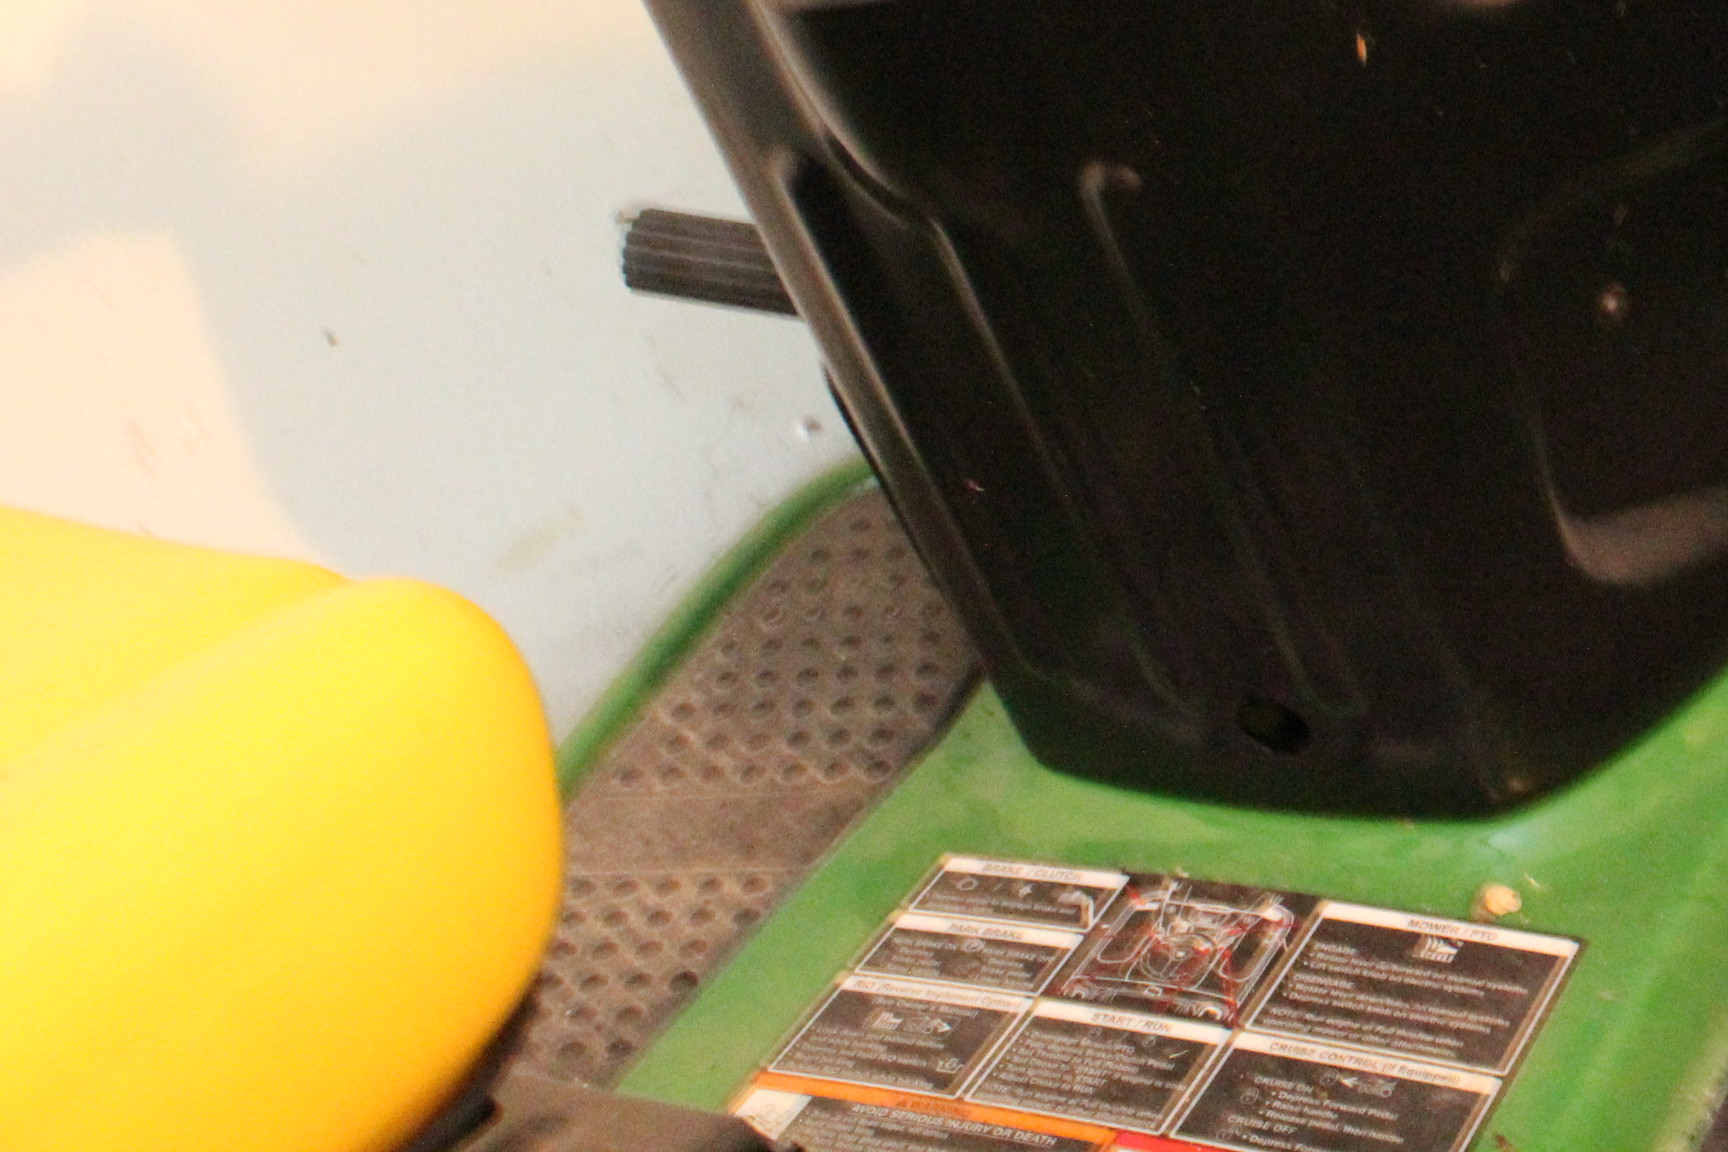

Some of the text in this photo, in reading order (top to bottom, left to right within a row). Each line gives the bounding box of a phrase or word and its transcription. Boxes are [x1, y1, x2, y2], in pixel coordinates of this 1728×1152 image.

[982, 863, 1024, 875] BRAKE
[1034, 867, 1083, 881] CLUTCH
[948, 924, 1024, 939] PARK BRAKE
[1408, 919, 1460, 935] MOWER
[1470, 929, 1498, 940] PTO
[1091, 1012, 1134, 1026] START
[1144, 1019, 1172, 1032] RUN
[1270, 1041, 1316, 1057] CRUISE
[1318, 1049, 1378, 1069] CONTROL
[1254, 1074, 1314, 1094] CRUISE ON
[852, 1103, 890, 1118] AVOID
[890, 1109, 944, 1126] SERIOUS
[947, 1119, 993, 1135] INJURY
[993, 1127, 1013, 1138] OR
[1013, 1130, 1058, 1146] DEATH
[1227, 1113, 1298, 1135] CRUISE OFF
